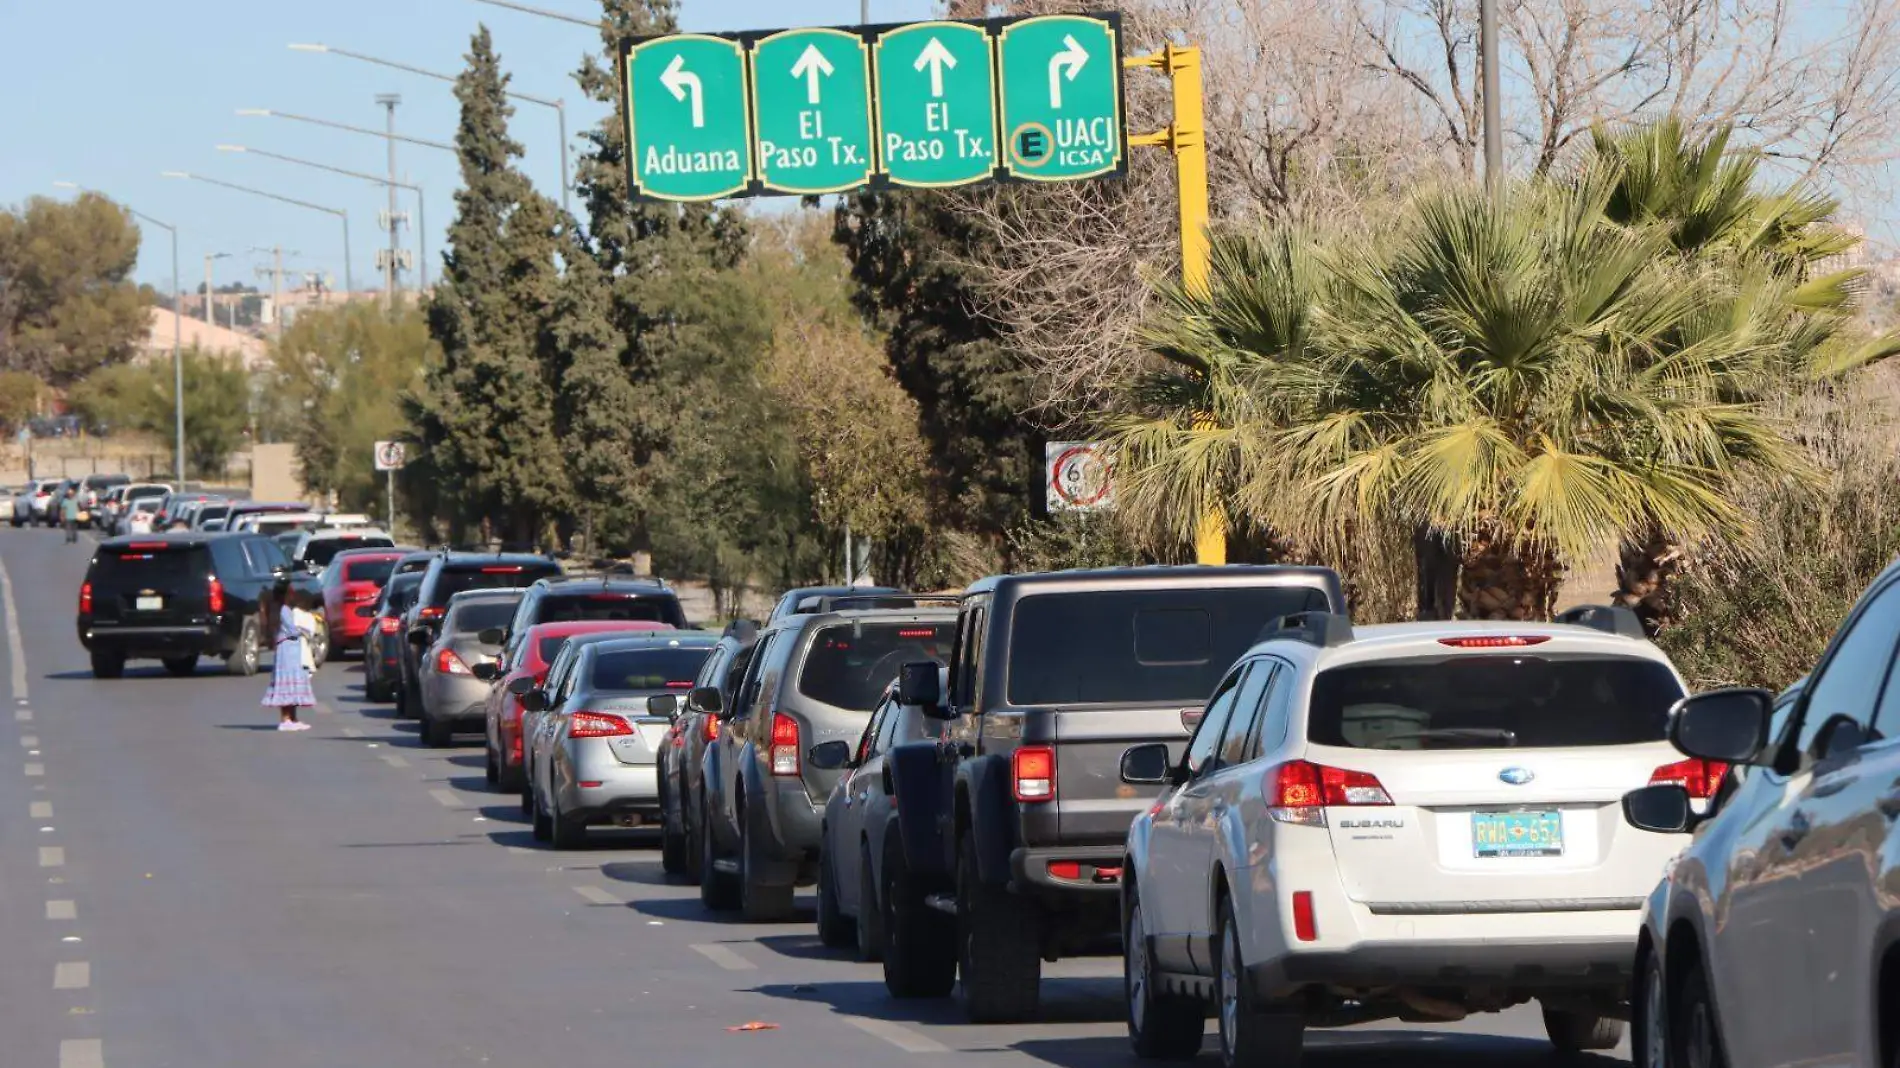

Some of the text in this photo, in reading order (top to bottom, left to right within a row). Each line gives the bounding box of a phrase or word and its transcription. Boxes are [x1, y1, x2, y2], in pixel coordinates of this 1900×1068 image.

[799, 110, 822, 139] El
[926, 102, 949, 132] El
[887, 128, 992, 162] Paso Tx.
[1021, 132, 1043, 157] E
[1056, 117, 1114, 152] UACJ
[644, 144, 740, 175] Aduana
[760, 137, 866, 169] Paso Tx.
[1060, 149, 1104, 166] ICSA
[1340, 820, 1404, 828] SUBARU
